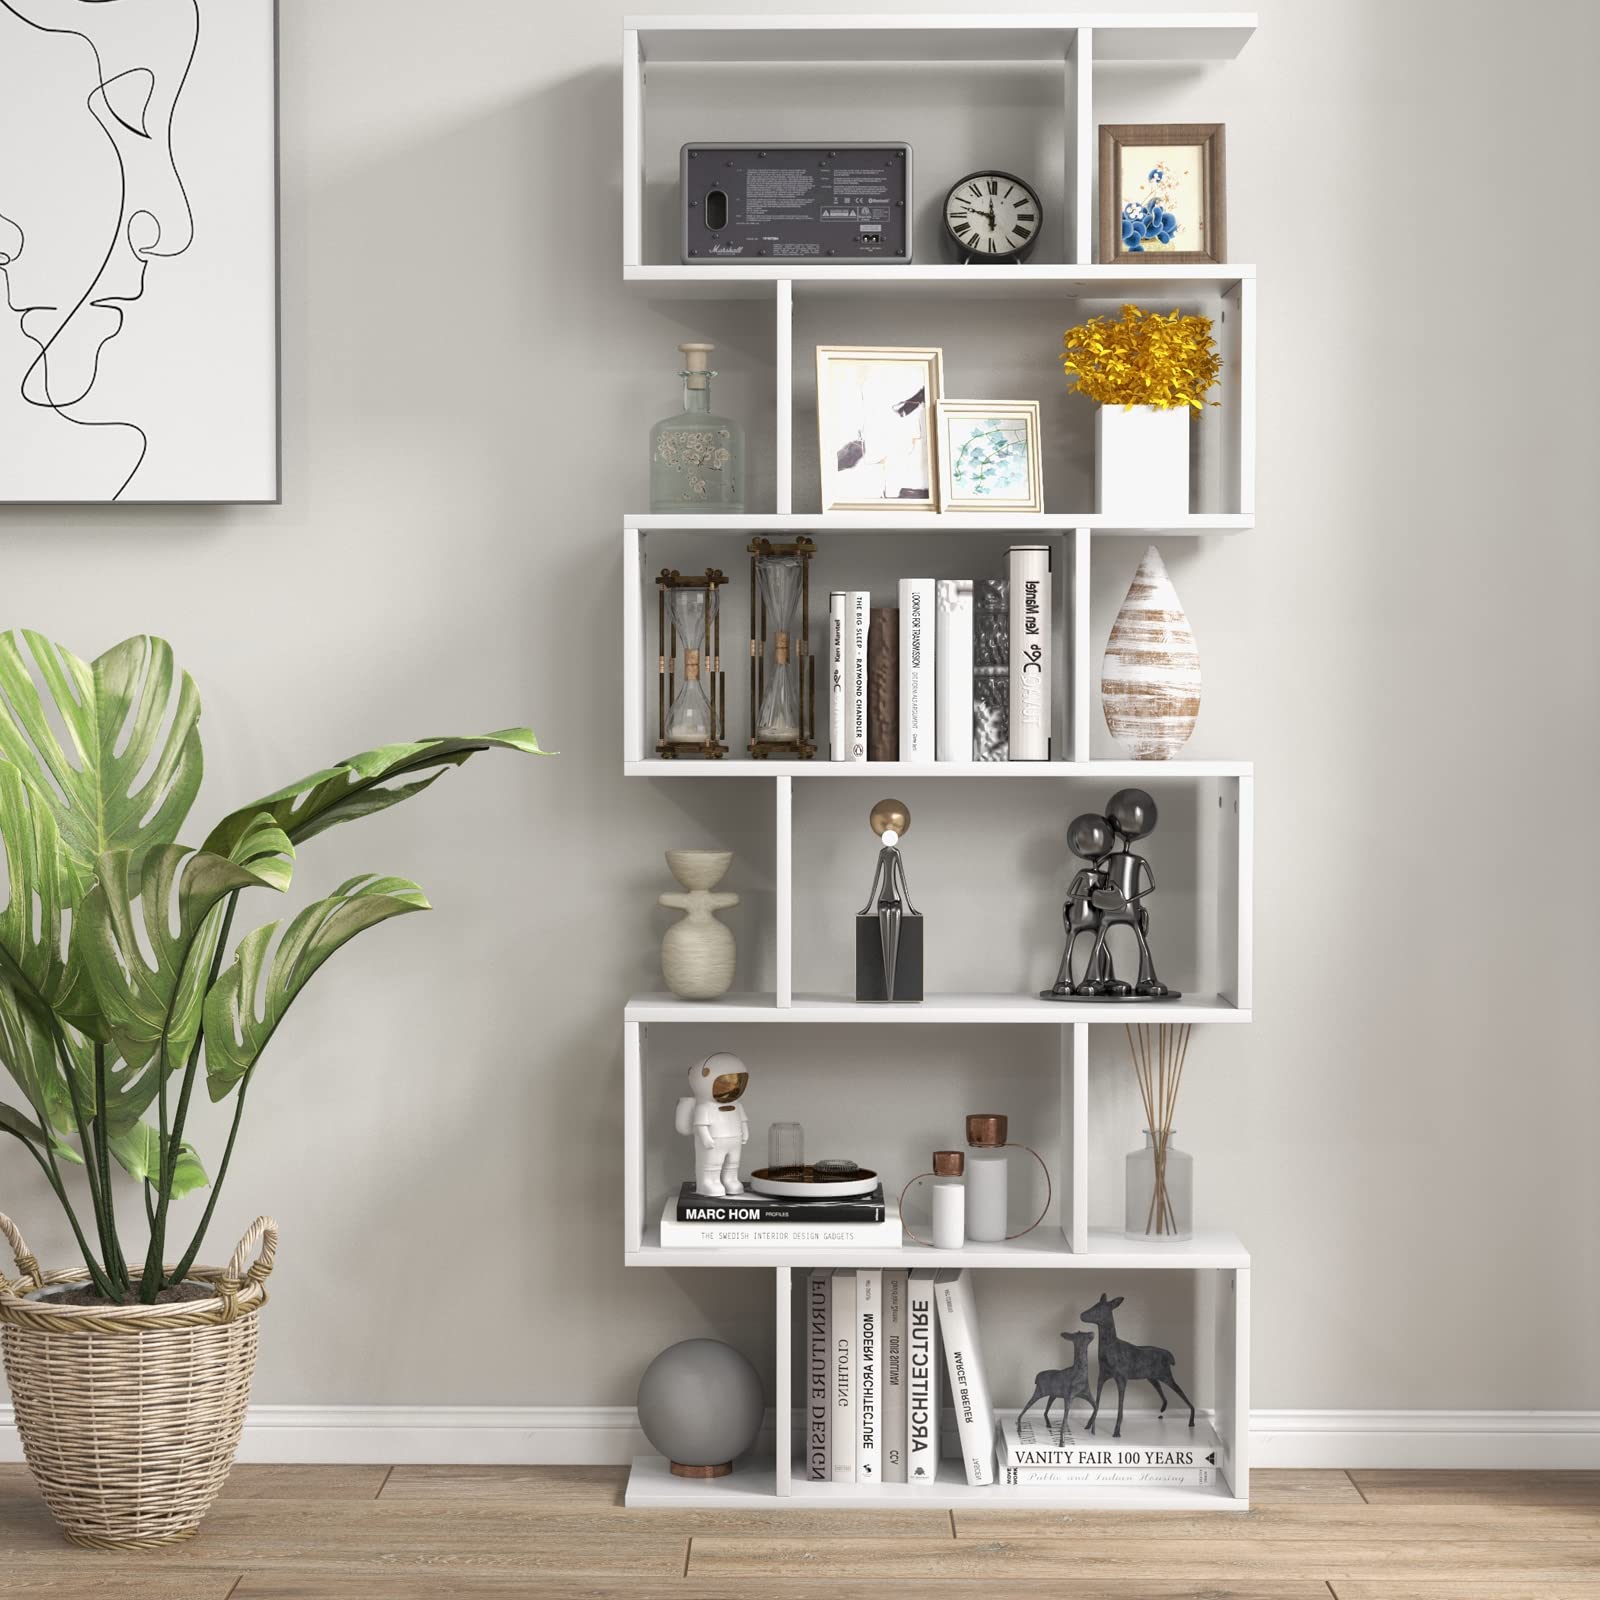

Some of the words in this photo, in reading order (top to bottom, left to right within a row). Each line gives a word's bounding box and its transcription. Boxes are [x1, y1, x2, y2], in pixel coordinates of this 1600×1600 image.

[709, 244, 744, 254] Marshall
[911, 592, 921, 617] LOOKING
[911, 617, 921, 628] FOR
[911, 629, 921, 668] TRANSMISSION
[855, 658, 863, 697] RAYMOND
[855, 699, 863, 738] CHANDLER
[686, 1208, 726, 1220] MARC
[729, 1208, 760, 1220] HOM
[701, 1232, 714, 1240] THE
[719, 1232, 749, 1240] SWEDISH
[754, 1232, 788, 1240] INTERIOR
[793, 1232, 819, 1240] DESIGN
[823, 1232, 854, 1240] GADGETS
[1015, 1451, 1074, 1464] VANITY
[1079, 1451, 1112, 1464] FAIR
[1117, 1451, 1140, 1464] 100
[1146, 1451, 1193, 1464] YEARS
